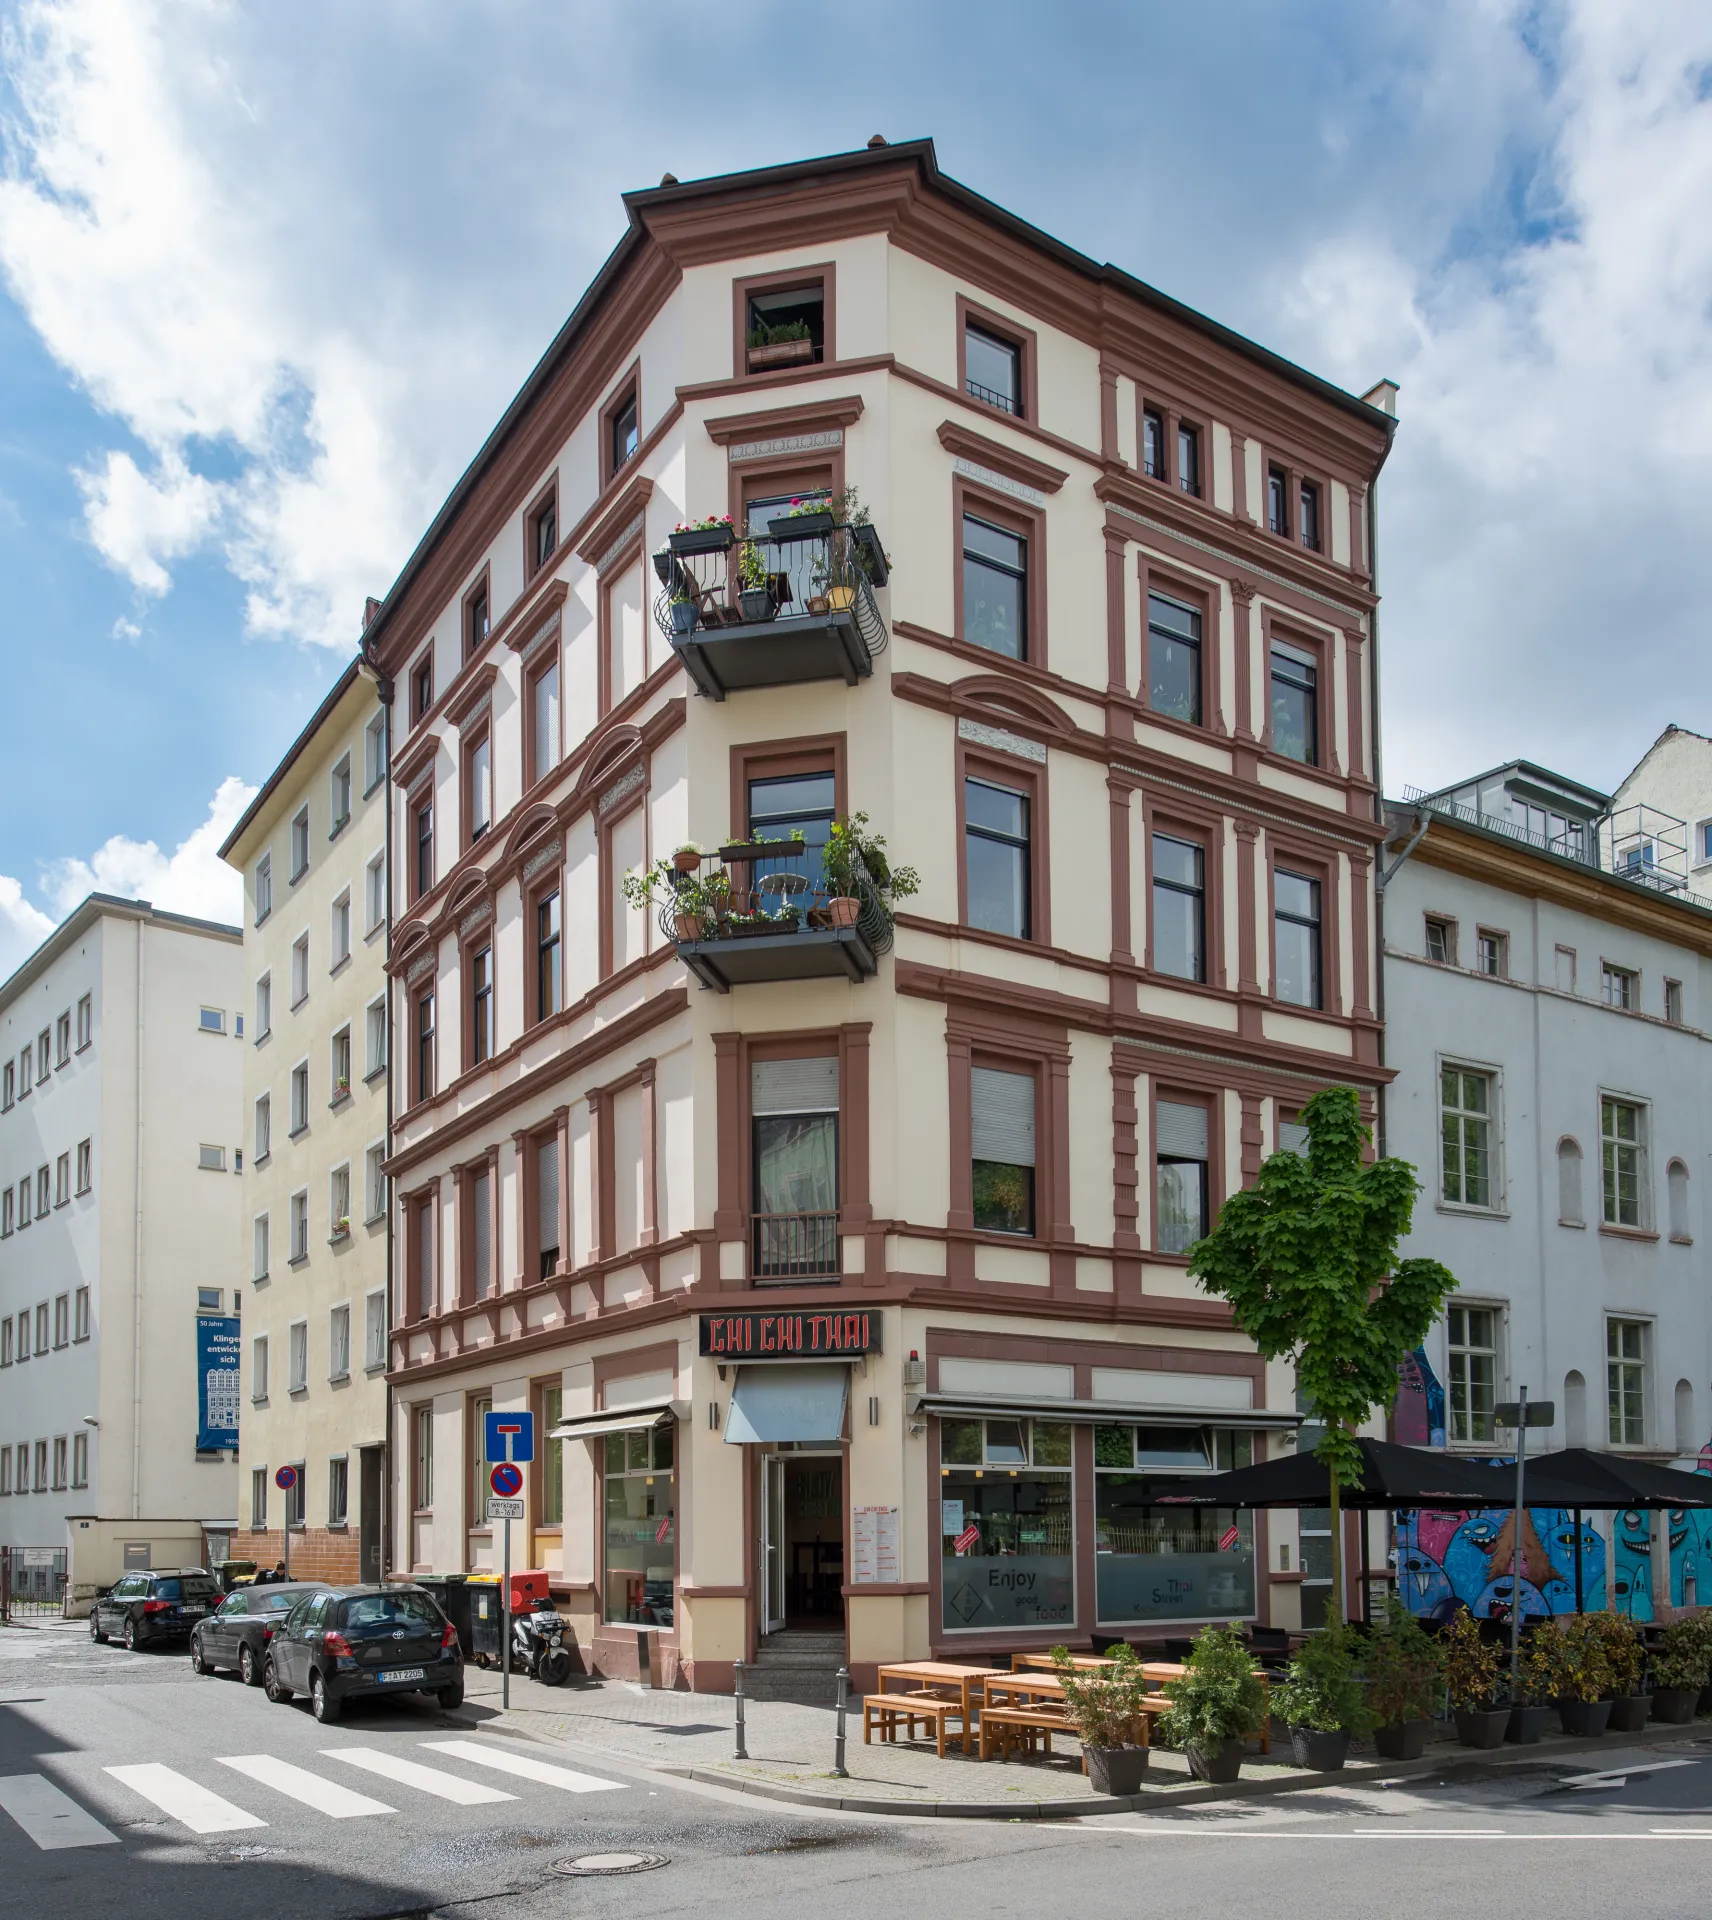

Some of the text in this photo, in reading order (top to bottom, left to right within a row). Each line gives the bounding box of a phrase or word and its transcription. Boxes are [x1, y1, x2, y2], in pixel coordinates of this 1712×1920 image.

[710, 1314, 869, 1352] CHI CHI THAI
[220, 1355, 236, 1363] sich
[491, 1502, 520, 1510] werktags
[988, 1569, 1036, 1590] Enjoy
[1167, 1578, 1193, 1593] Thai
[1015, 1594, 1038, 1607] good
[1152, 1588, 1183, 1604] Street
[1036, 1605, 1066, 1620] food
